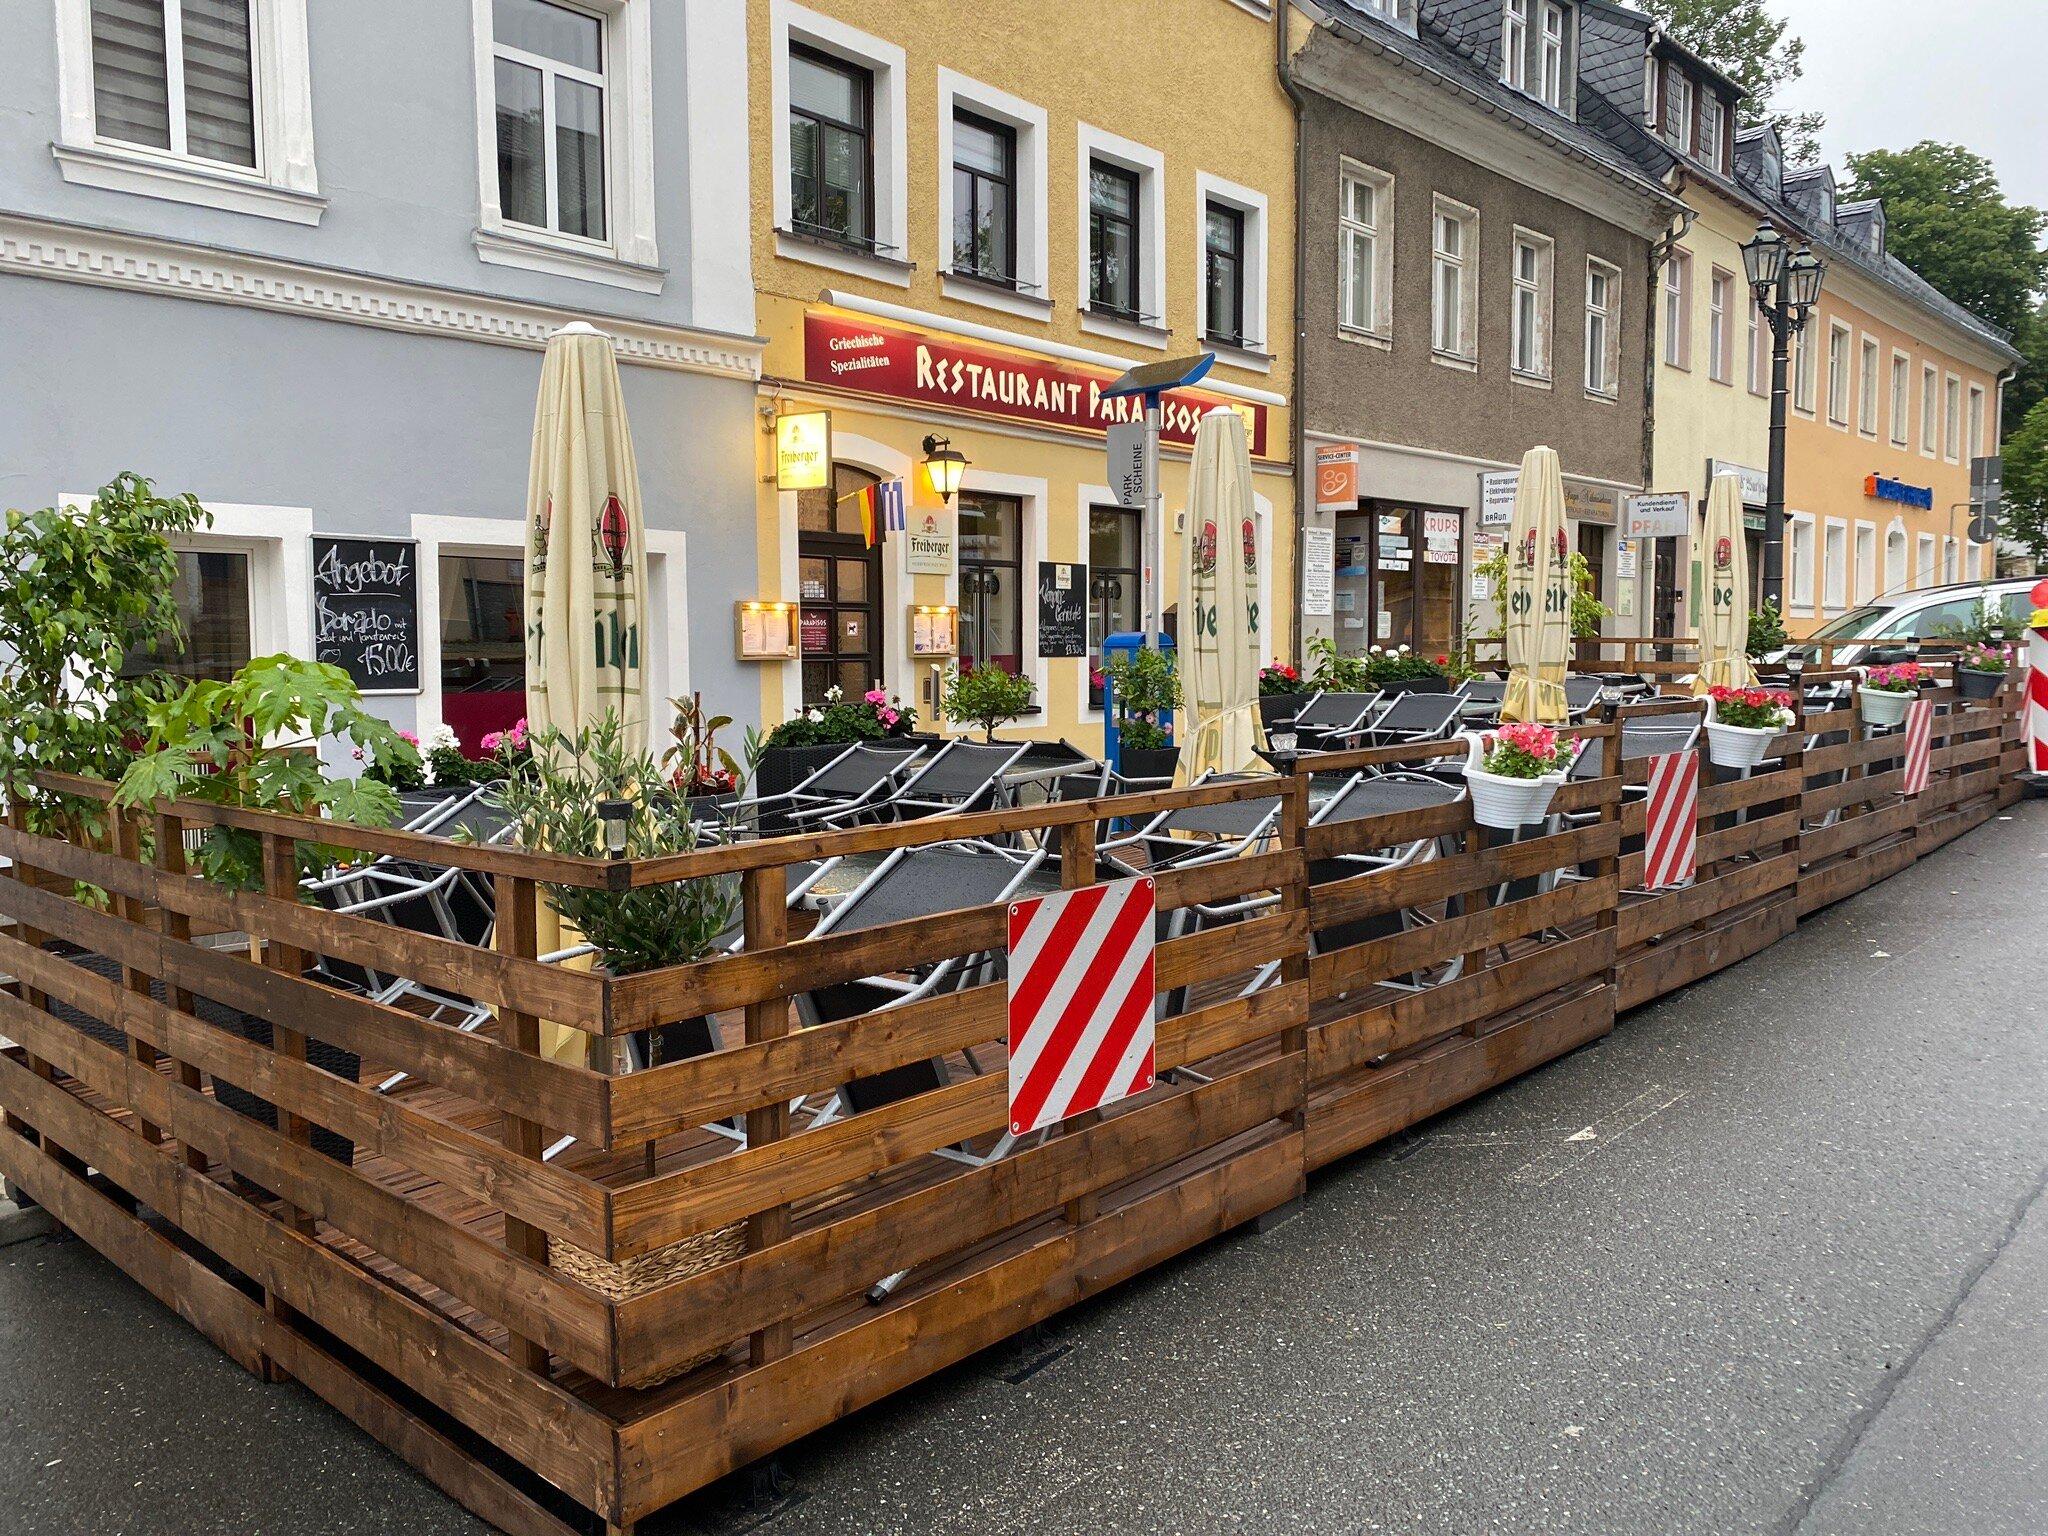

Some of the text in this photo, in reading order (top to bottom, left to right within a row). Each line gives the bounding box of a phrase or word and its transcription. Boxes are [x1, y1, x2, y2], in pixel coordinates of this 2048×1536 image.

[829, 334, 885, 351] Griechische
[830, 355, 890, 375] Spezialitäten
[1089, 379, 1201, 436] PARAISOS
[781, 450, 819, 466] Freiberger
[1133, 443, 1143, 493] SCHEINE
[1123, 474, 1133, 506] PARK
[1637, 499, 1678, 507] Kundendienst
[910, 537, 950, 557] Freiberger
[1430, 552, 1457, 563] TOYOTA
[314, 544, 410, 593] Angebot
[315, 596, 408, 635] Dorado mit
[338, 632, 354, 643] und
